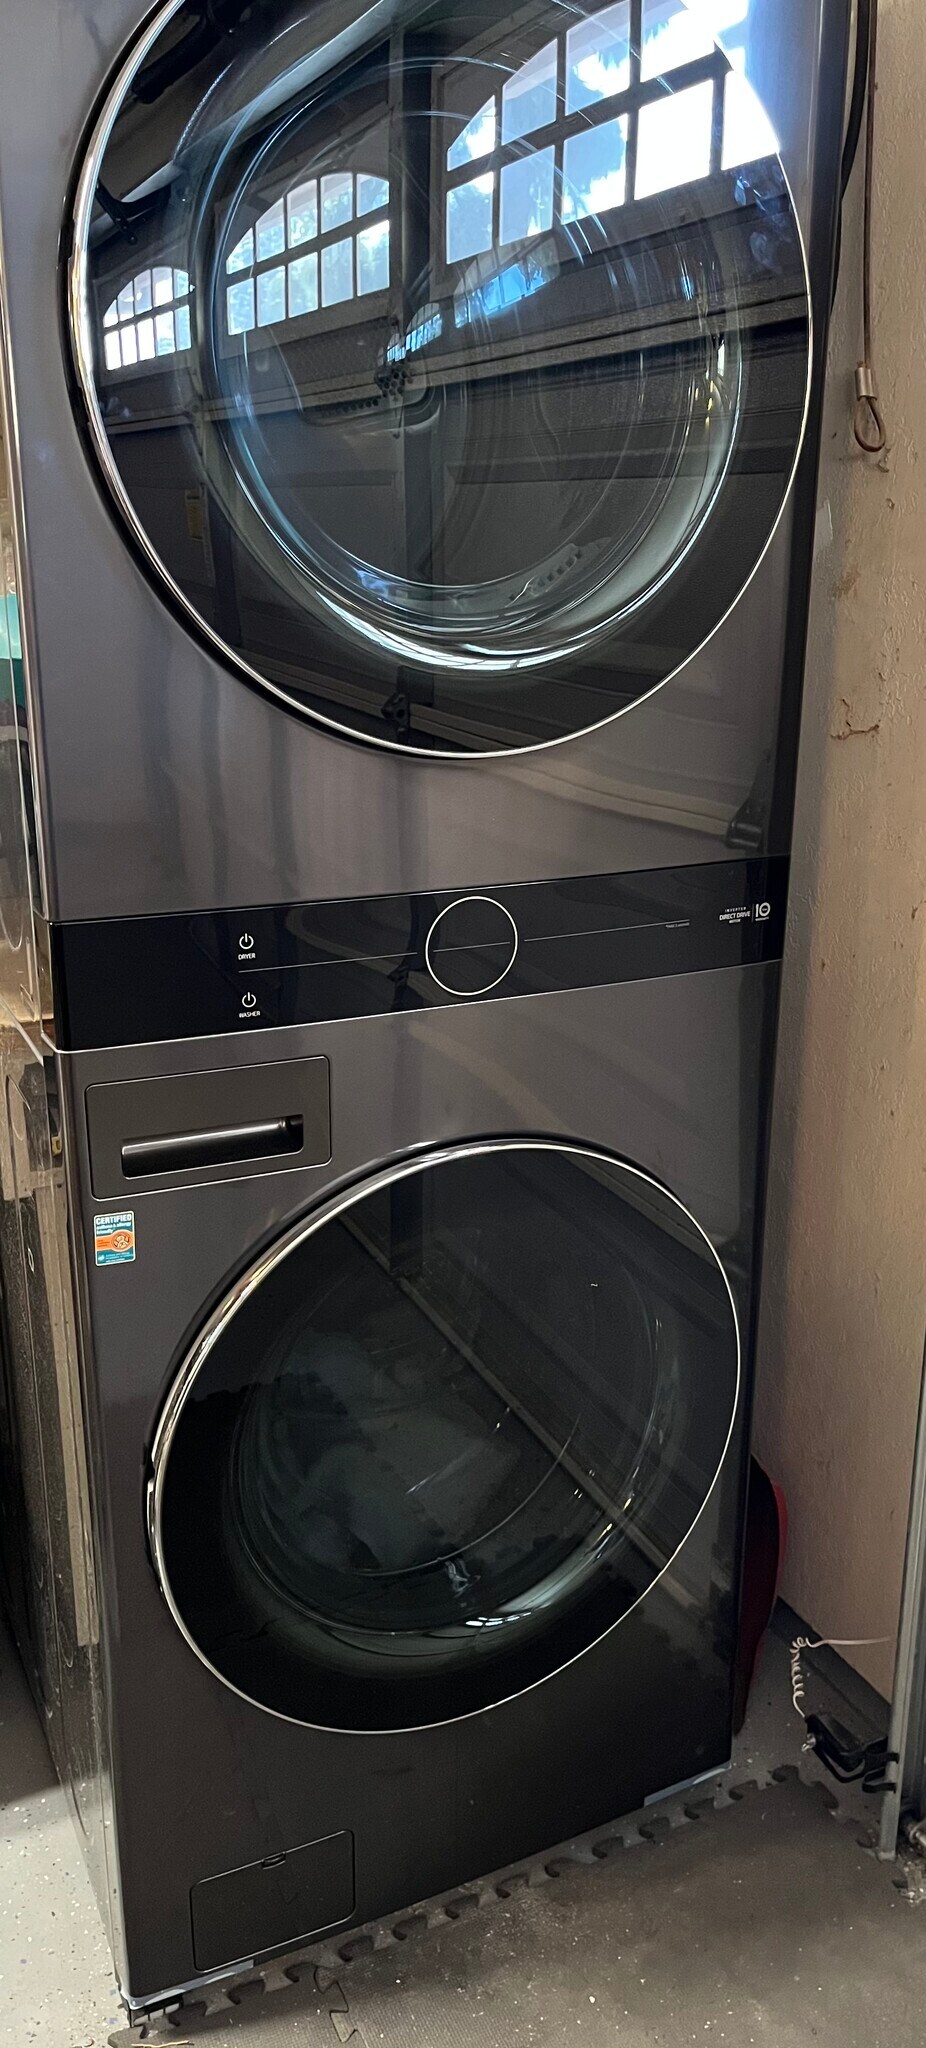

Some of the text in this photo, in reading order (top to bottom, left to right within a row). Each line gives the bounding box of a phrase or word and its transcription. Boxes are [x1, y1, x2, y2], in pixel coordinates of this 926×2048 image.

[719, 912, 736, 921] DIRECT
[736, 910, 751, 918] DRIVE
[96, 1214, 132, 1225] CERTIFIED
